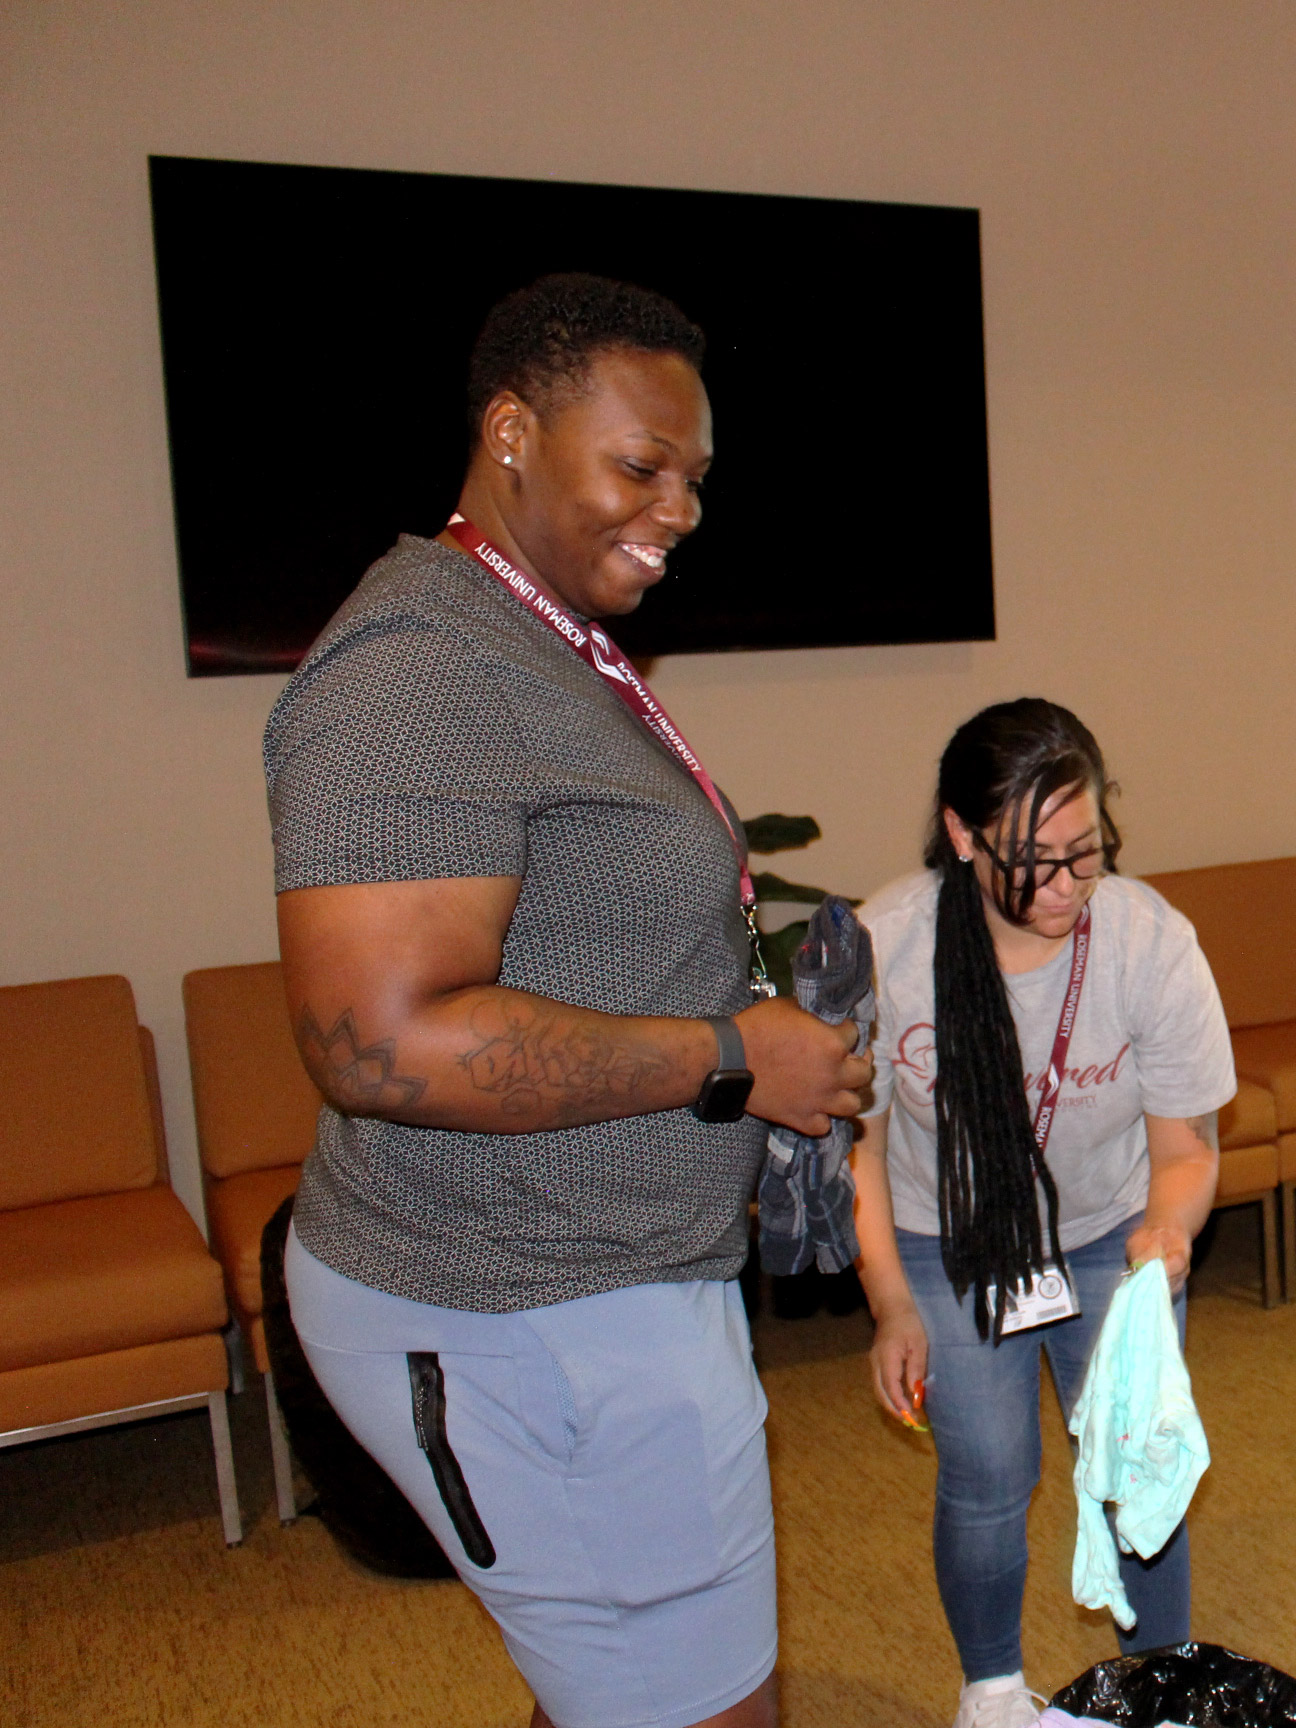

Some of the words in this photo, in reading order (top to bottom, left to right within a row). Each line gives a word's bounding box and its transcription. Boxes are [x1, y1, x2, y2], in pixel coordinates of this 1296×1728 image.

[474, 541, 537, 601] UNIVERSITY
[533, 595, 588, 648] ROSEMAN
[1073, 933, 1088, 982] ROSEMAN
[1059, 983, 1080, 1038] UNIVERSITY
